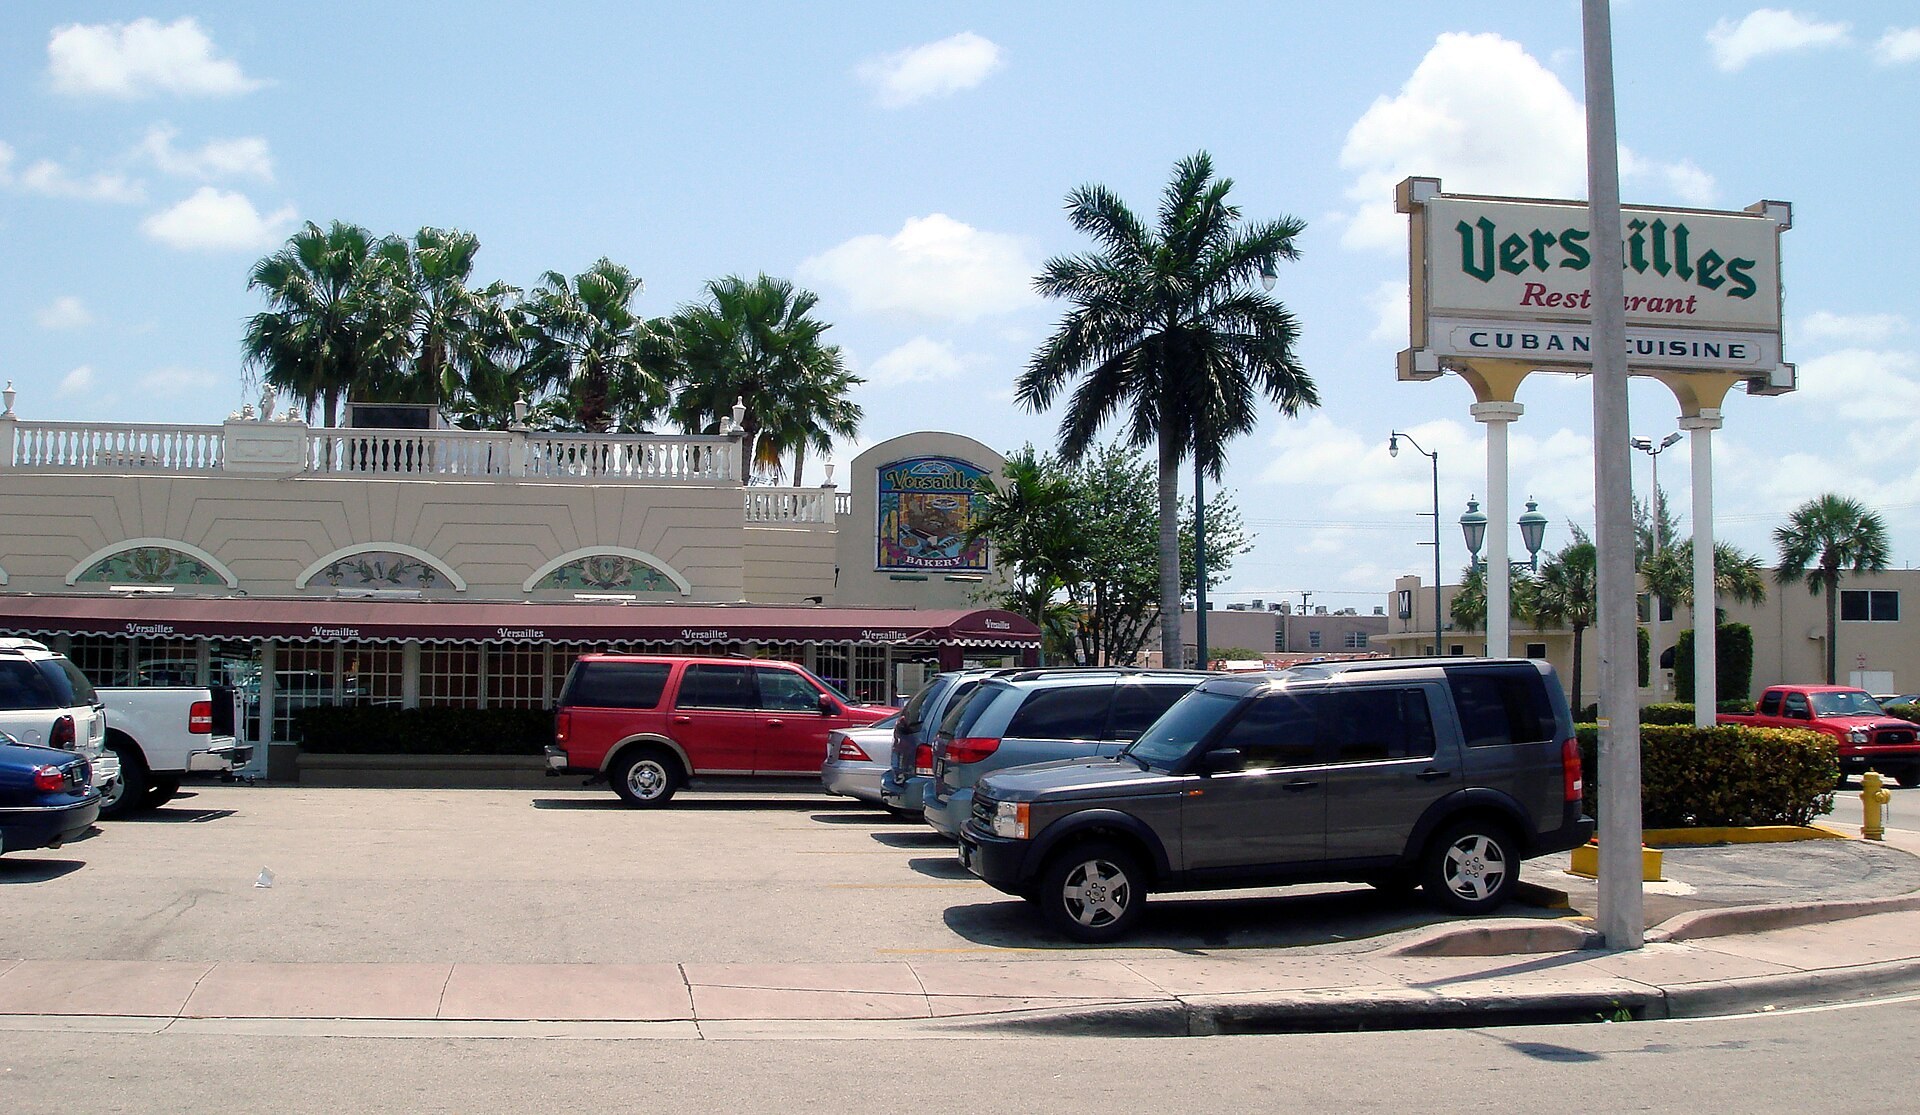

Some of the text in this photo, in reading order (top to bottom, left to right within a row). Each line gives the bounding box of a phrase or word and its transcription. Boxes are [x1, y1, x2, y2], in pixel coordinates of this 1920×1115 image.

[1455, 216, 1757, 299] Versilles
[1520, 282, 1697, 315] Restrant
[1469, 332, 1590, 351] CUBAN
[885, 468, 981, 490] Versaille
[905, 555, 961, 567] BAKERY
[1399, 591, 1409, 612] M
[125, 622, 174, 634] Versailles
[311, 625, 359, 637] Versailles
[497, 627, 544, 638] Versailles
[681, 628, 728, 639] Versailles
[861, 629, 907, 641] Versailles
